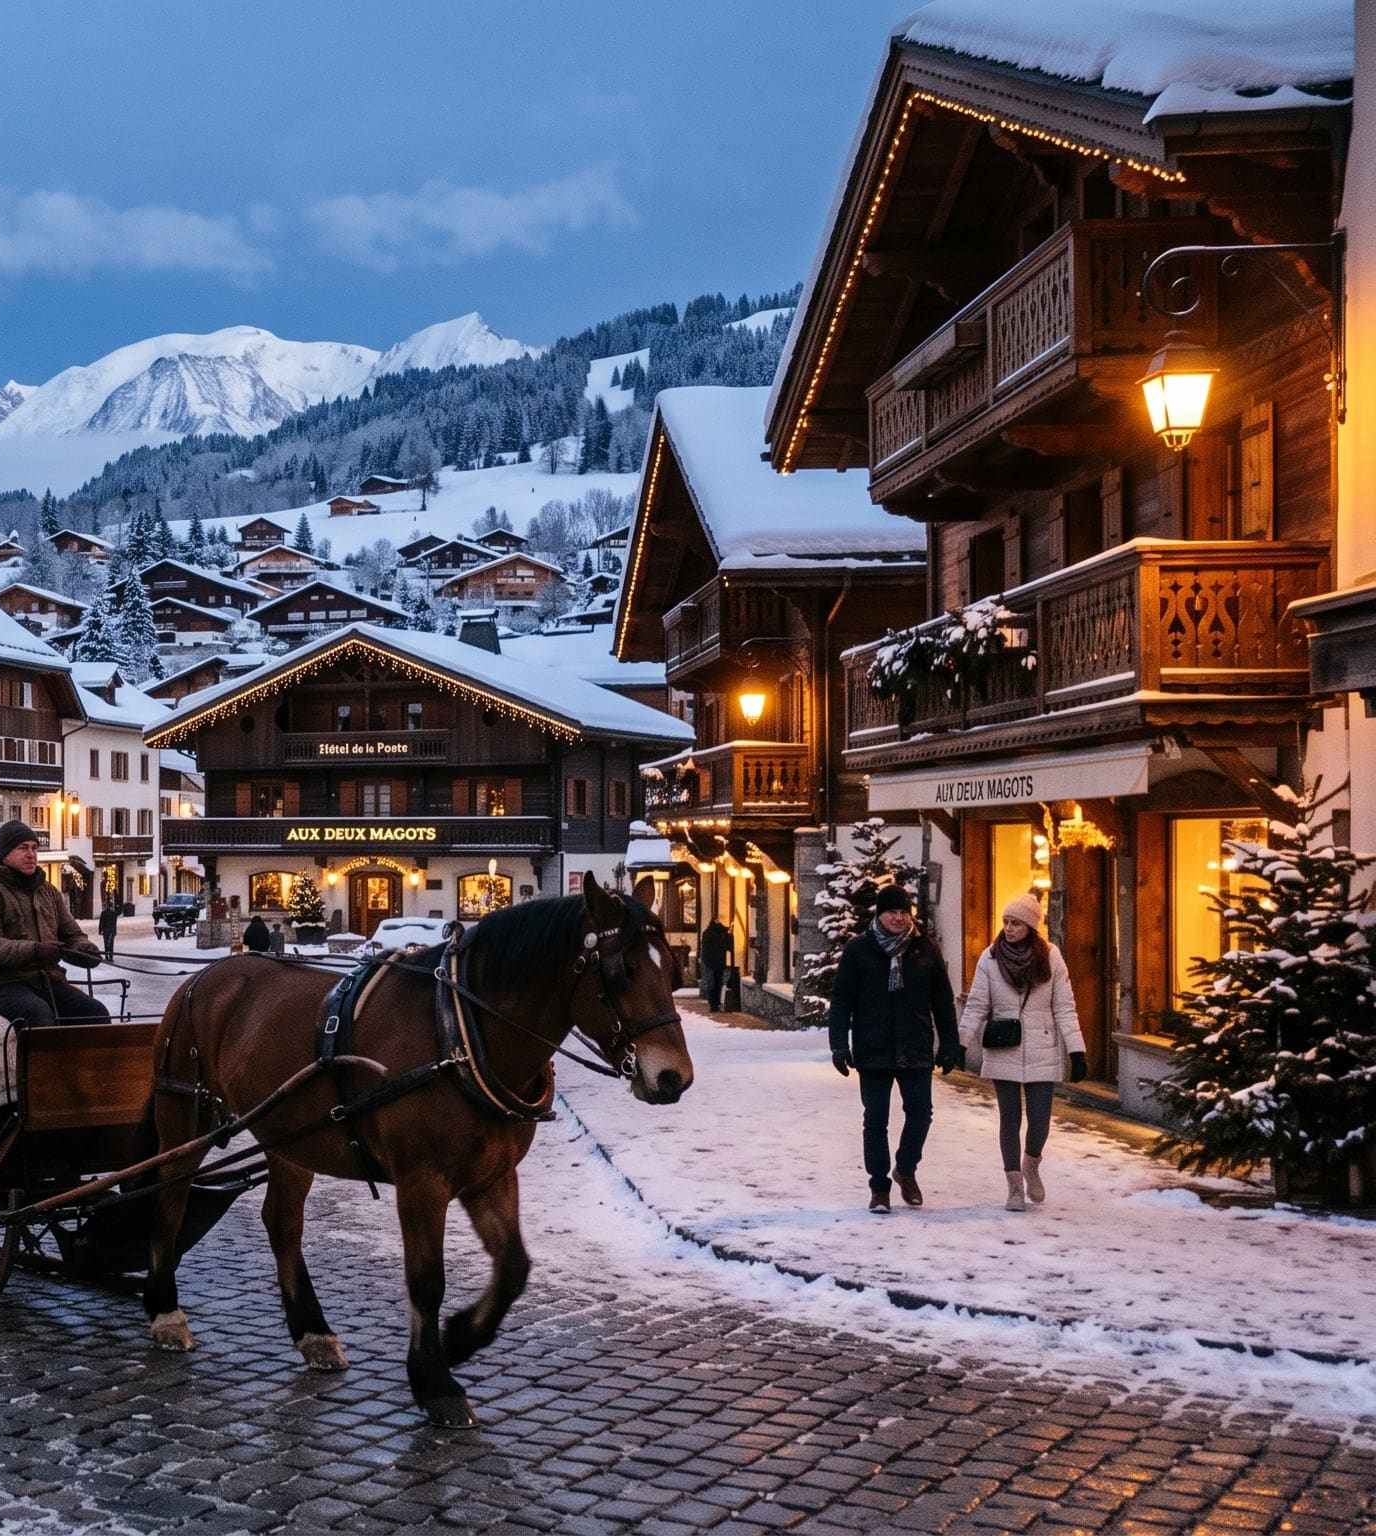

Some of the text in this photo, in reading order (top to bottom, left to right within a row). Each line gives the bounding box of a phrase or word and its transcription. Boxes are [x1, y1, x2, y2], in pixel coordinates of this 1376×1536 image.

[935, 775, 1034, 803] AUX DEUX MAGOTS
[287, 827, 436, 841] AUX DEUX MAGOTS
